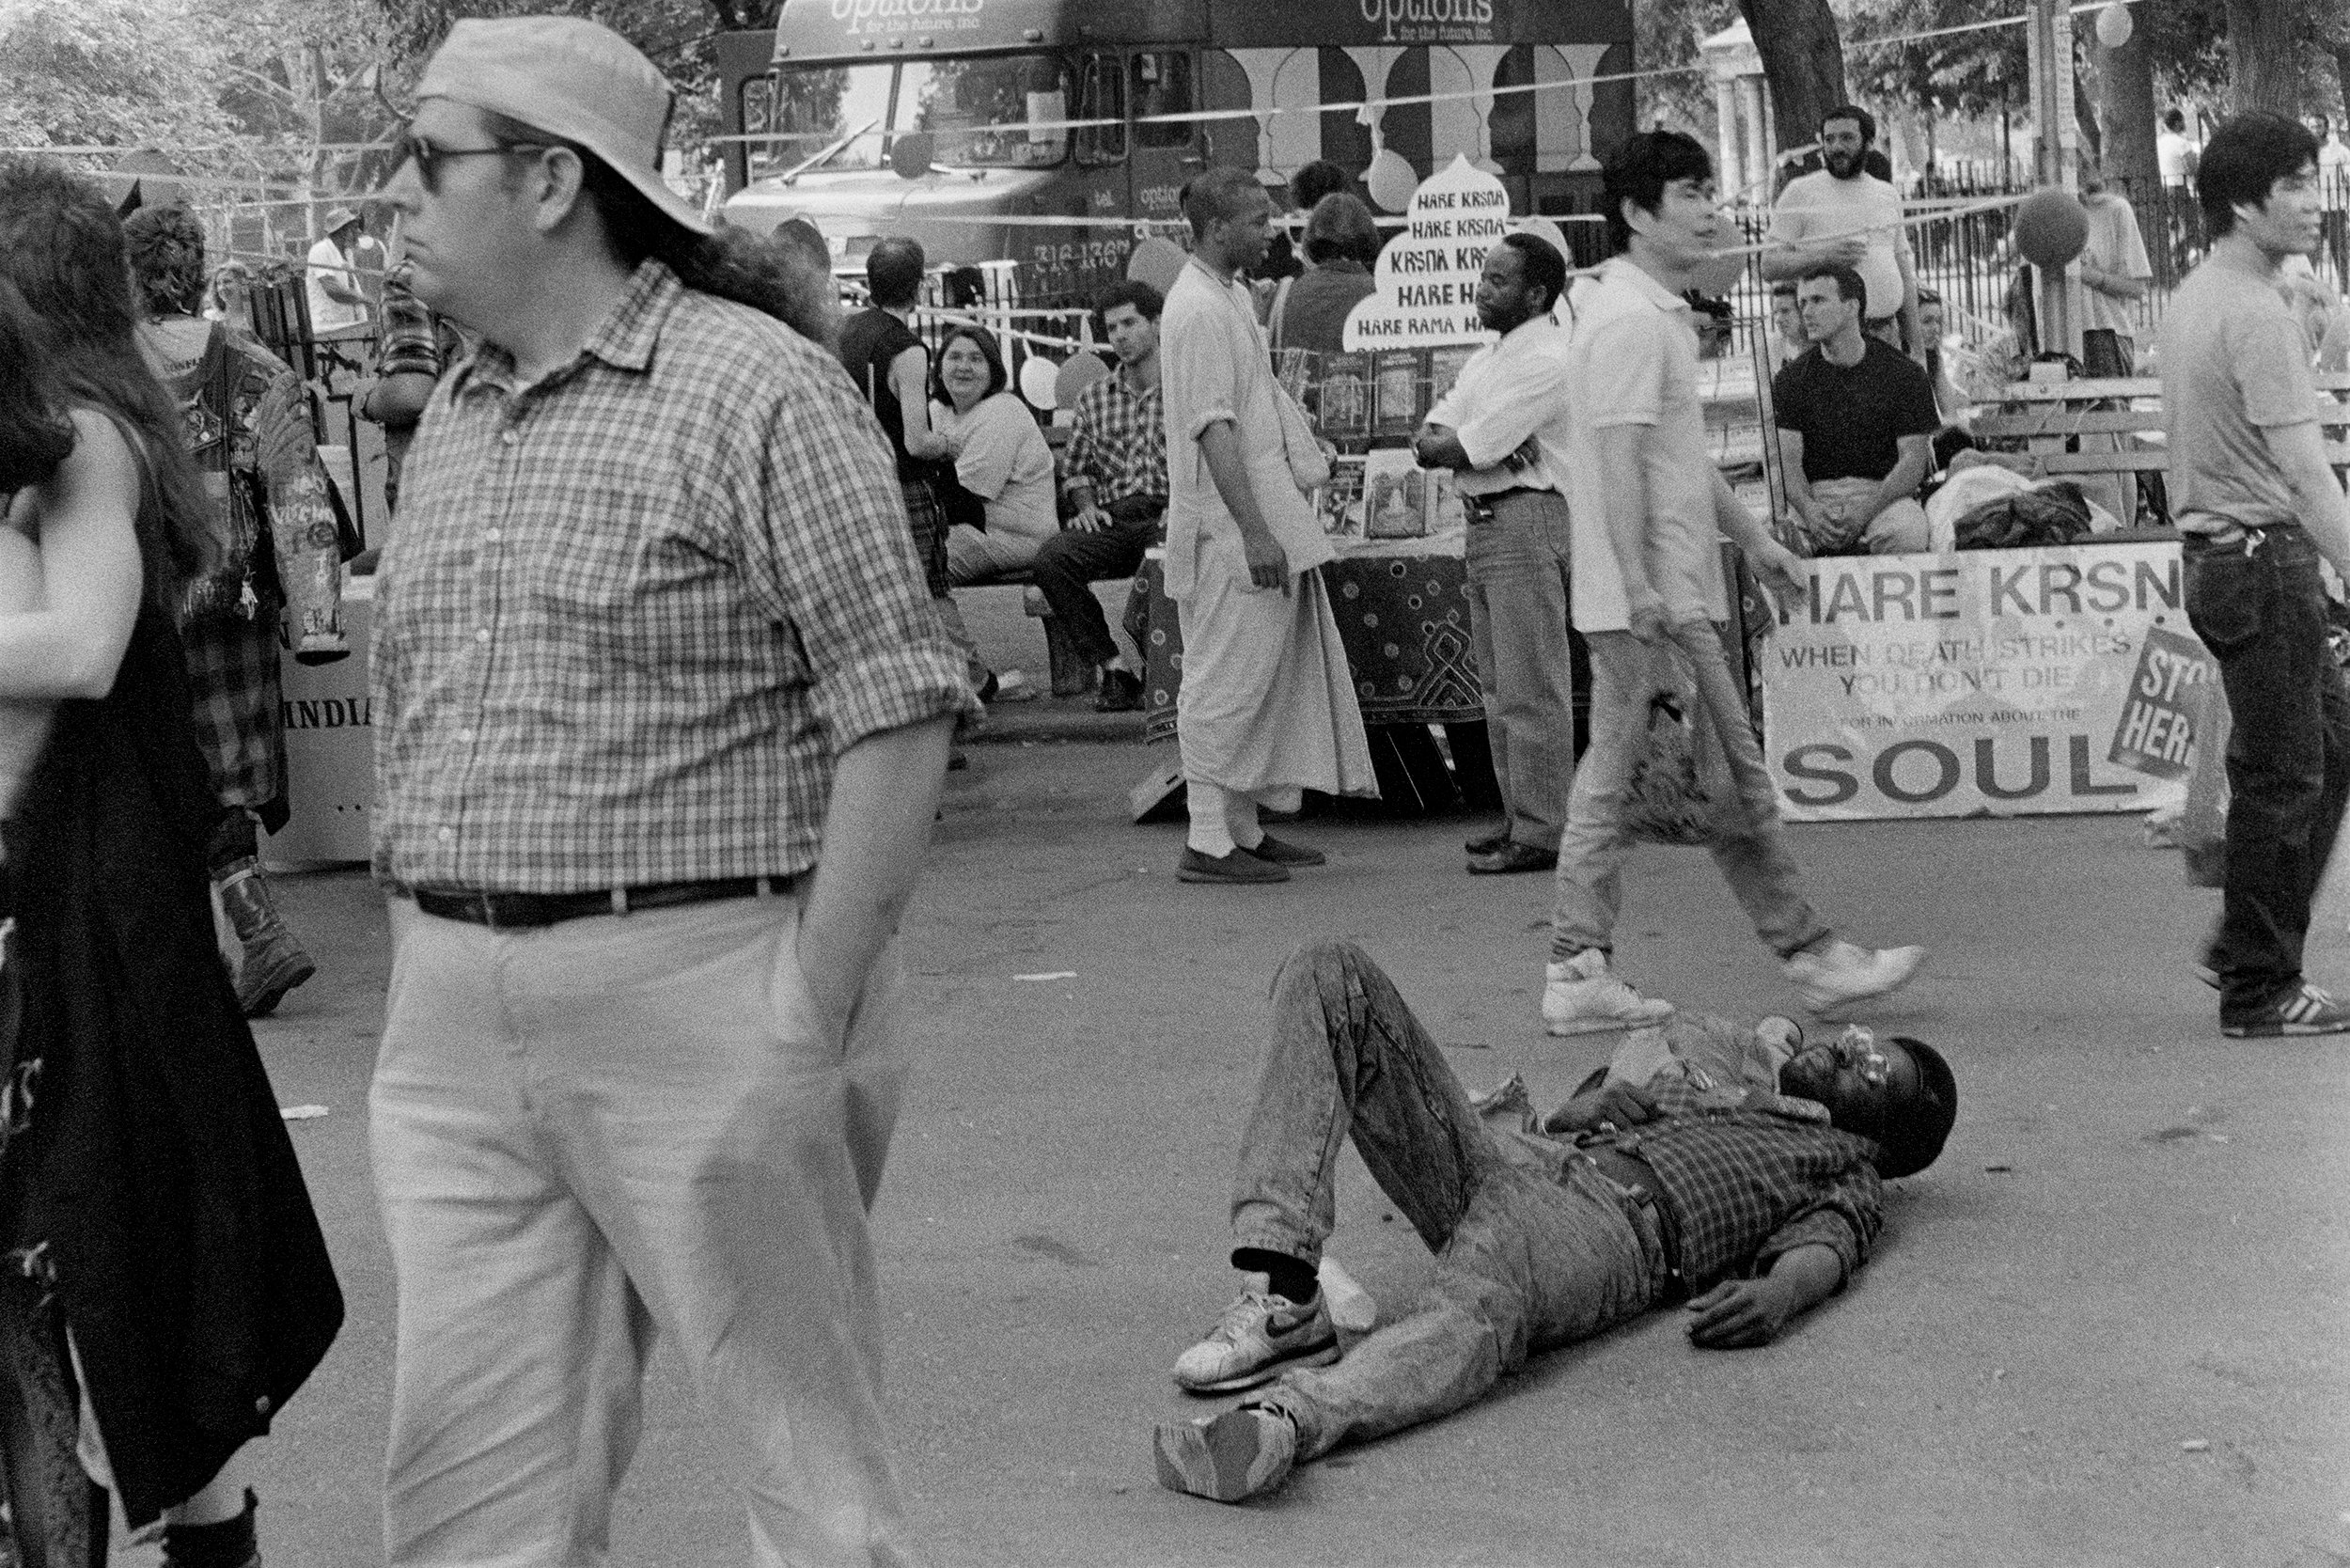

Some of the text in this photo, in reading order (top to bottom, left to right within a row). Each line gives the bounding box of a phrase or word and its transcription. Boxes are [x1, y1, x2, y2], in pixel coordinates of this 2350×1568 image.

[1418, 193, 1456, 210] HARE
[1412, 220, 1452, 239] HARE
[1398, 284, 1454, 307] HARE
[1357, 320, 1402, 336] HARE
[1408, 317, 1456, 335] RAMA
[1779, 633, 2131, 668] WHEN DEATH STRIKES
[1839, 673, 1900, 696] YOU
[1782, 734, 2138, 807] SOUL
